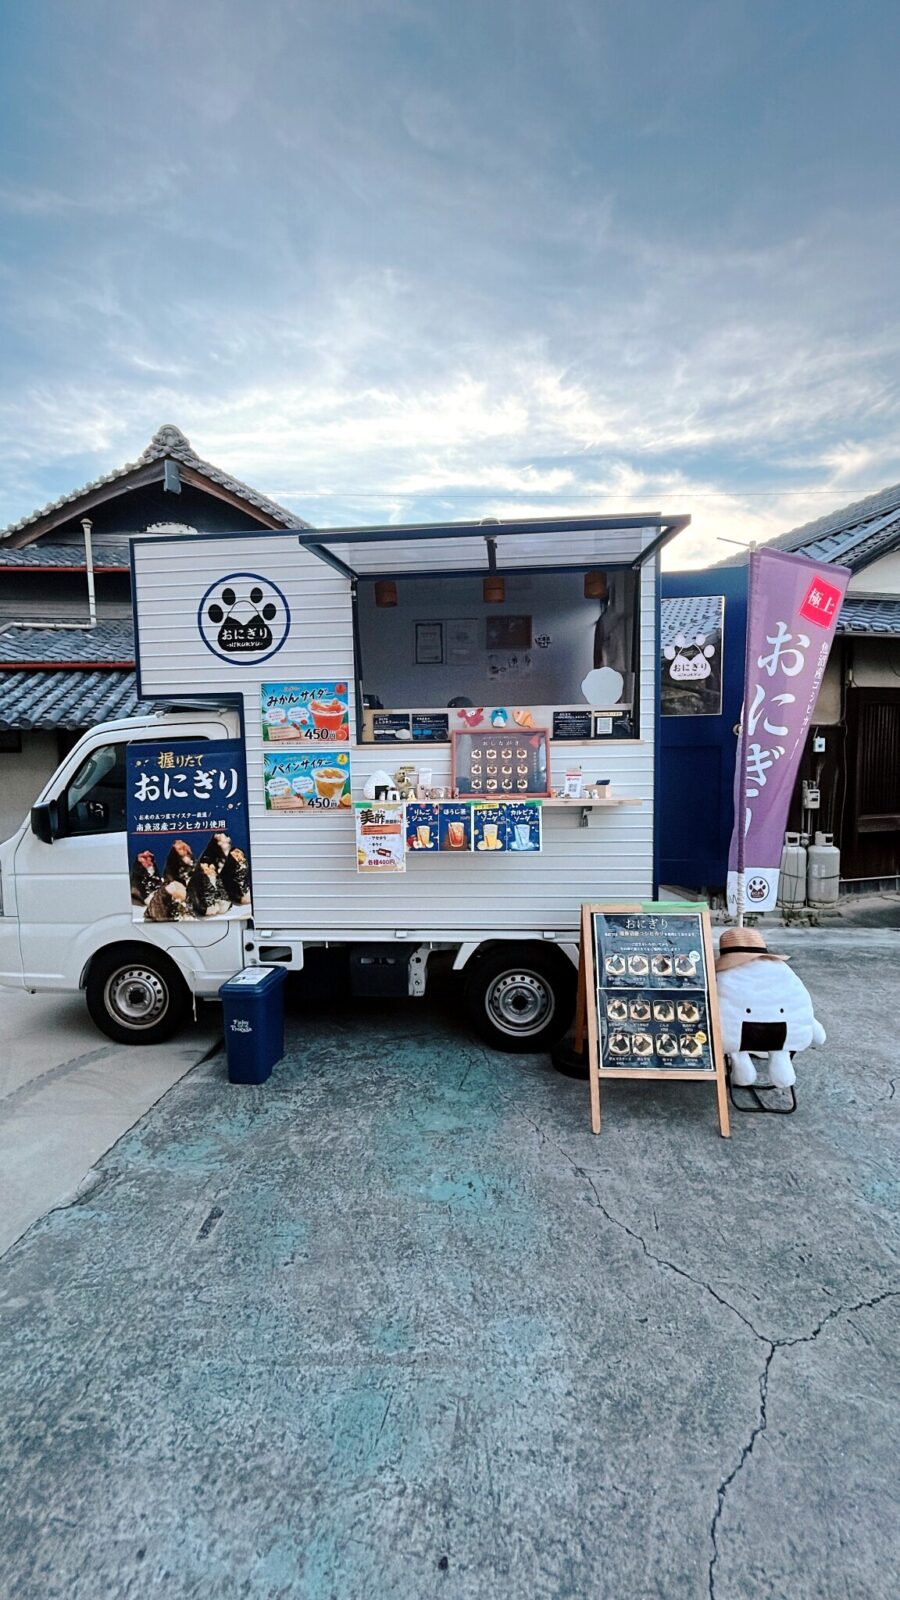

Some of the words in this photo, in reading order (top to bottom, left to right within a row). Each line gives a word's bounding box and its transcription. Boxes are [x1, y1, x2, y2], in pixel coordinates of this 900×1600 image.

[808, 588, 836, 615] 極上
[221, 627, 268, 640] おにぎり
[673, 663, 707, 672] おにぎり
[267, 688, 334, 707] みかんサイダー
[158, 751, 204, 769] 握りたて
[272, 759, 333, 776] パインサイダー
[134, 768, 238, 802] おにぎり
[136, 820, 226, 832] 南魚沼産コシヒカリ使用
[625, 918, 668, 930] おにぎり
